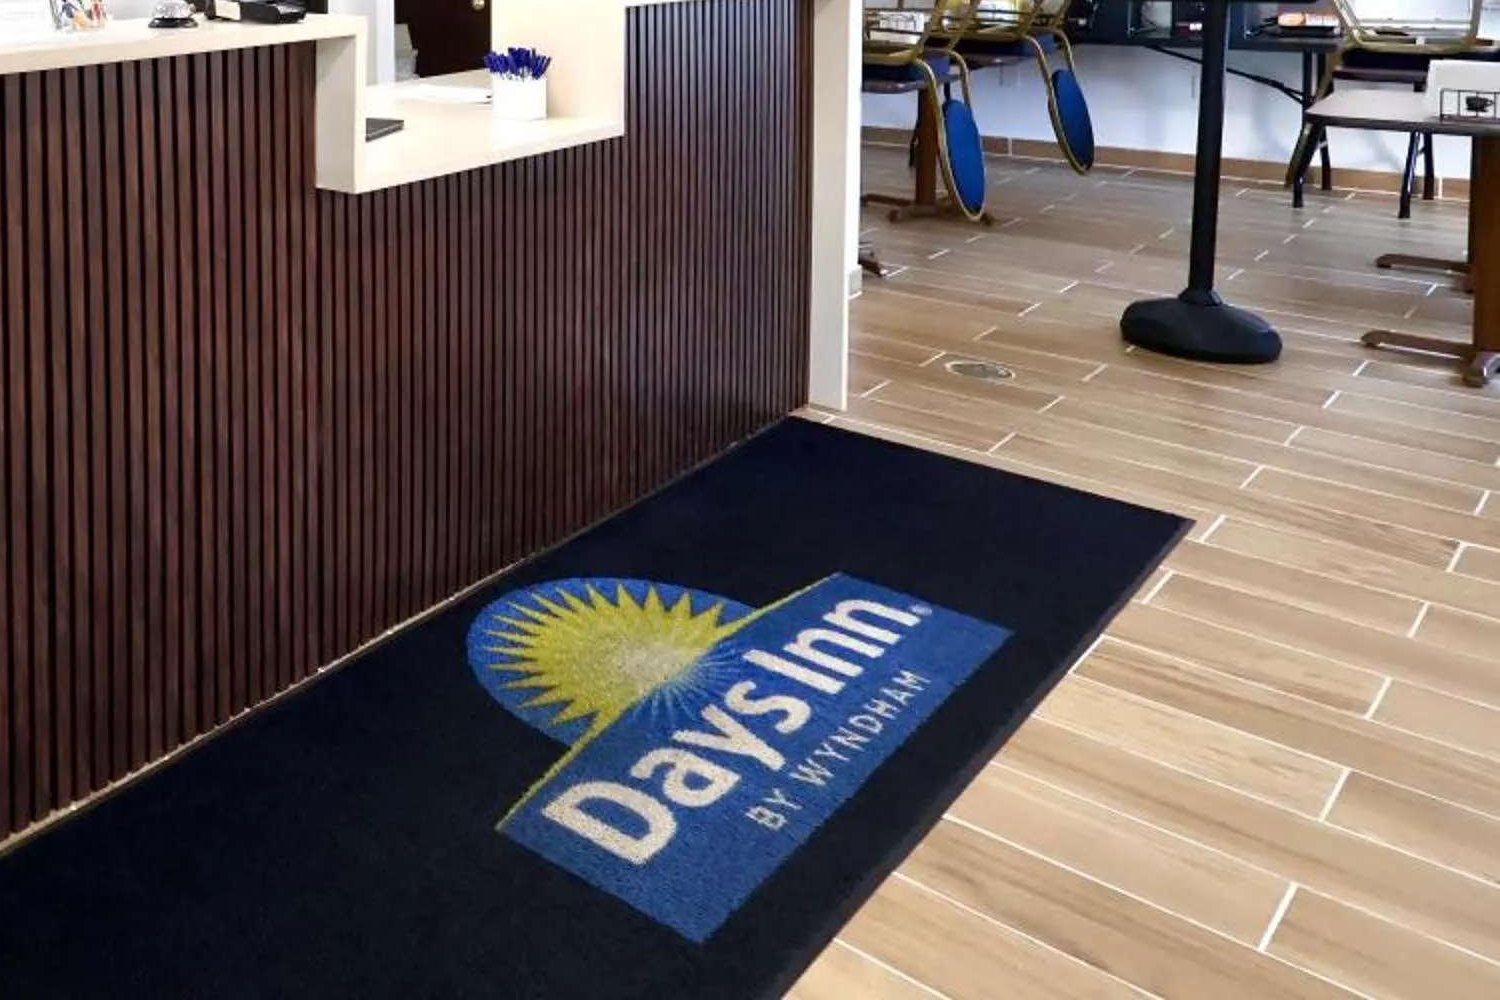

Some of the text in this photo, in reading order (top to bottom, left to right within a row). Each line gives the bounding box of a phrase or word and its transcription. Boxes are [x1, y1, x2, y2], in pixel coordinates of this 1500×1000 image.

[542, 680, 812, 866] Days
[745, 669, 932, 831] BY WYNDHAM
